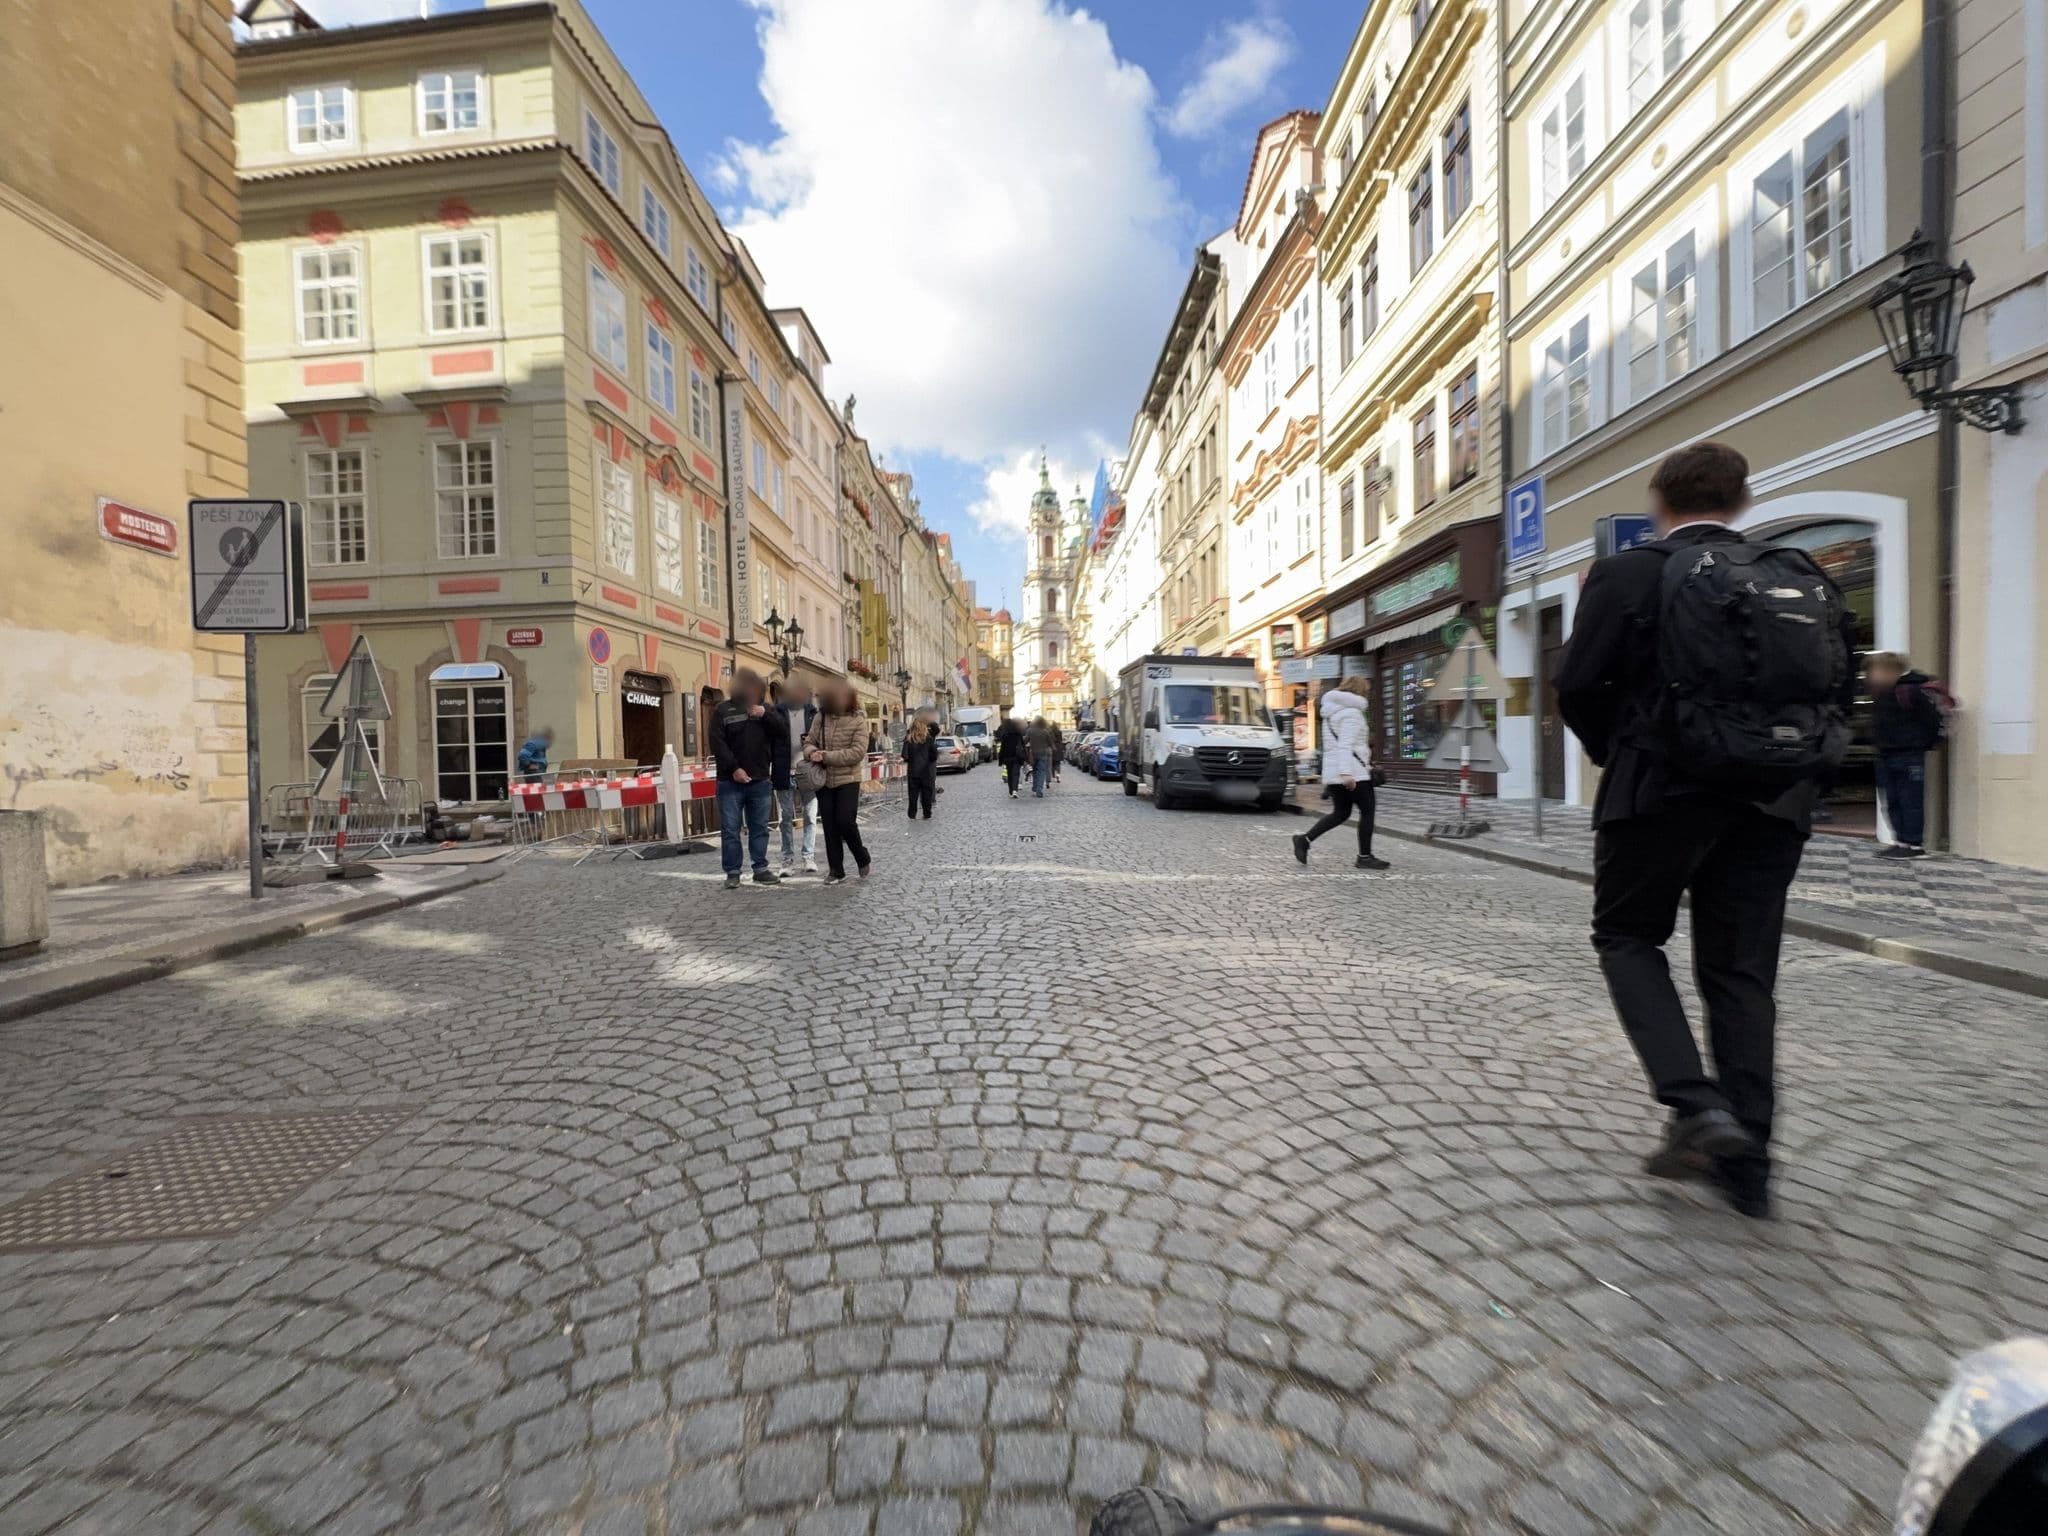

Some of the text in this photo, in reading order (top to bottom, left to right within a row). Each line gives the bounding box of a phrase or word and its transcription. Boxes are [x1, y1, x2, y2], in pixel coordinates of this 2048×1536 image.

[731, 409, 749, 628] DESIGN HOTEL DOMUS BALTHASAR
[1513, 490, 1537, 538] P
[440, 697, 466, 706] change
[626, 692, 661, 708] CHANGE
